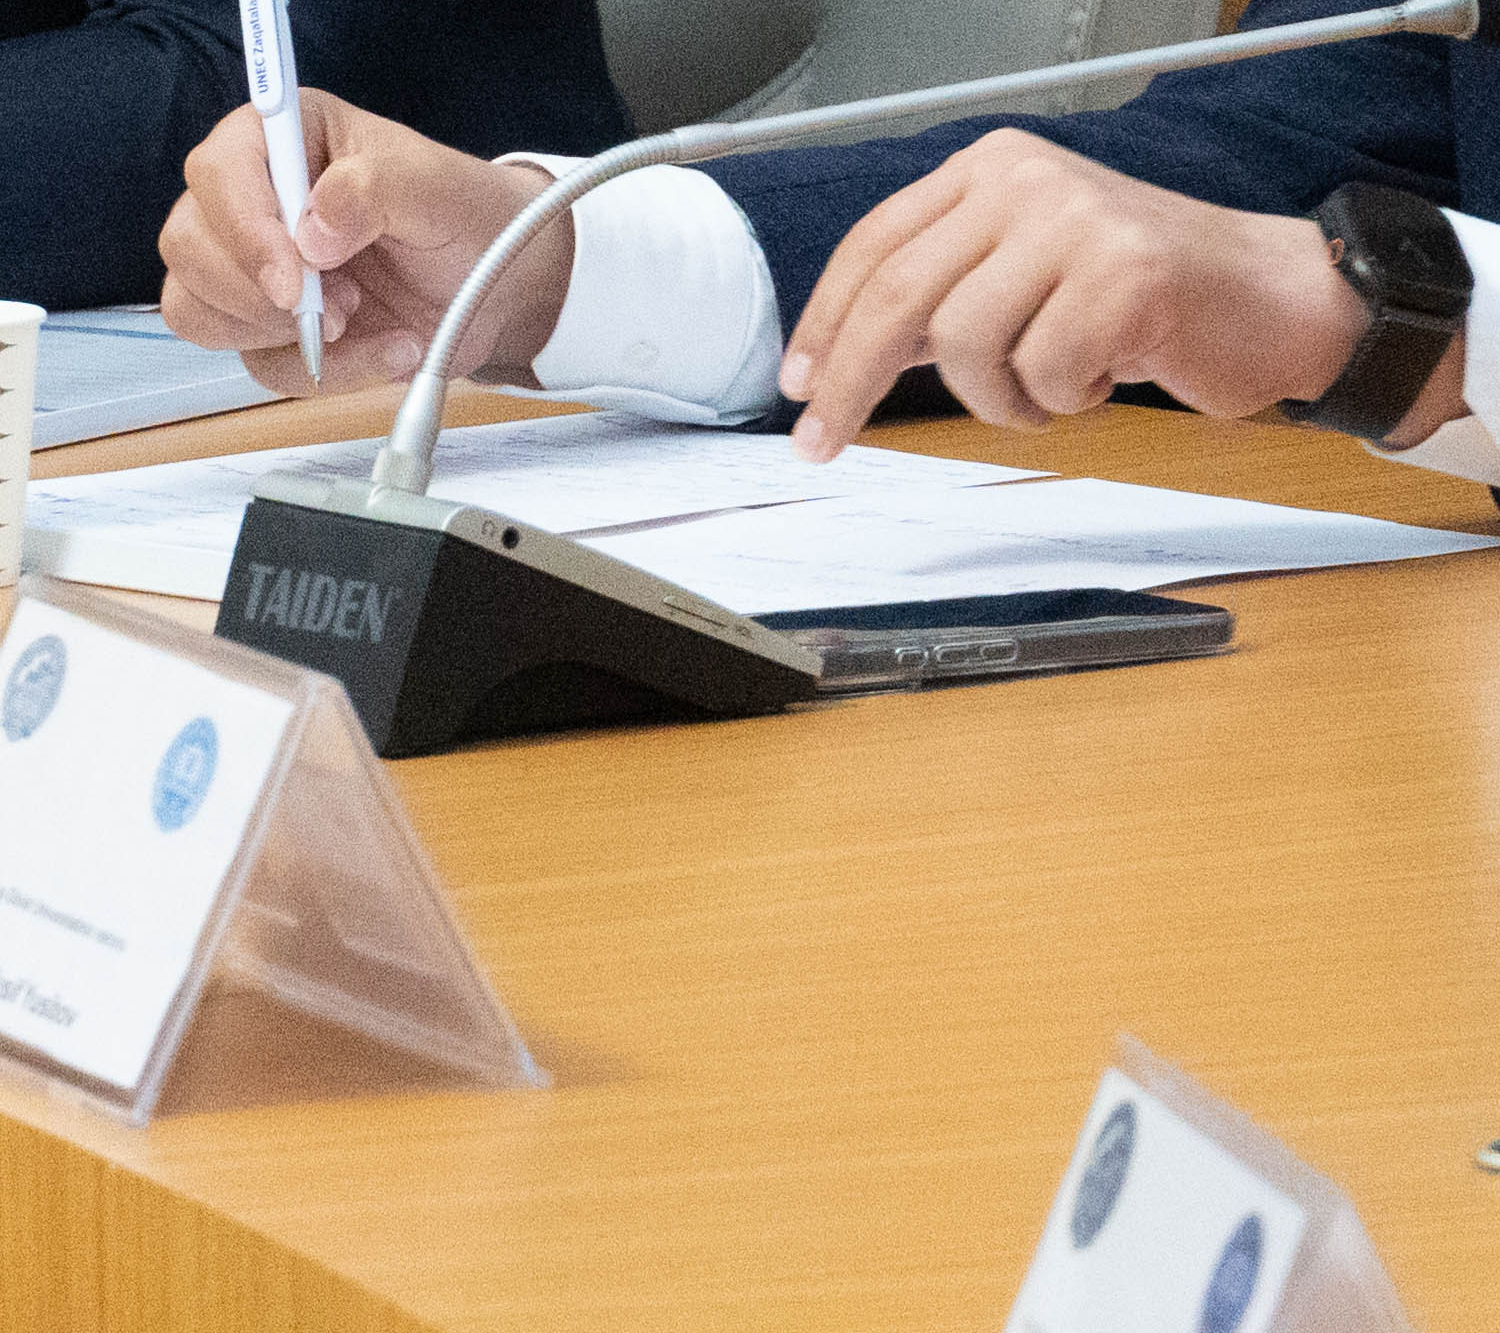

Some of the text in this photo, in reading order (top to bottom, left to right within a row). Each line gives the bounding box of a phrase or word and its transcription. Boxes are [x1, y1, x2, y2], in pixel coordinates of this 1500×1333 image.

[247, 0, 264, 54] Zaqatala
[254, 57, 269, 94] UNEC
[246, 561, 393, 645] TAIDEN
